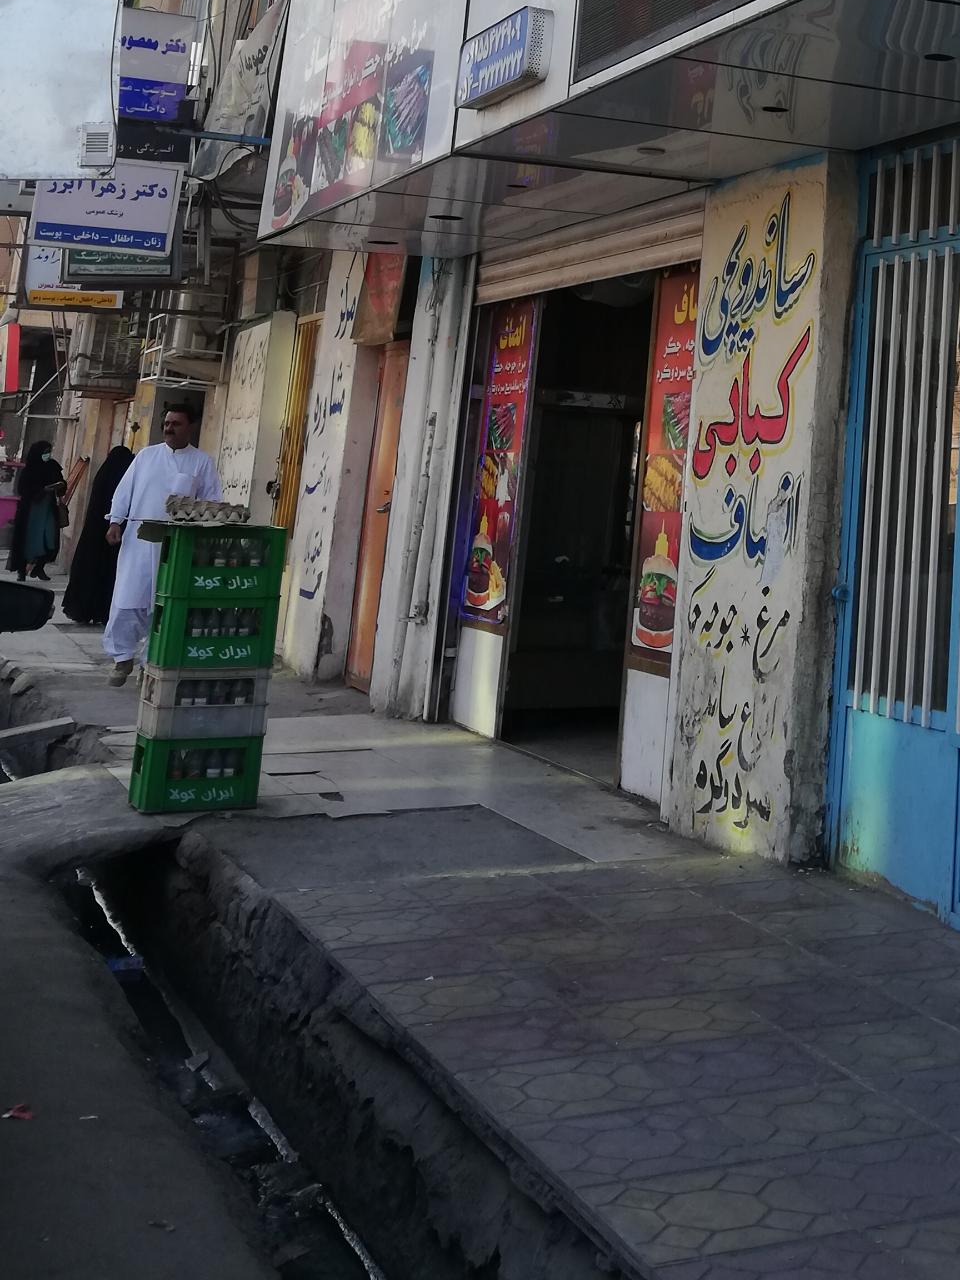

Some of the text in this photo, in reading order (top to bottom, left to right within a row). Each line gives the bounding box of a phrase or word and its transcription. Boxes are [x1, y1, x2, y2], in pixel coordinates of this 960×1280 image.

[130, 183, 168, 201] دکتر
[73, 232, 100, 242] داخلی
[110, 235, 133, 245] اطفال
[143, 236, 162, 248] زنان
[701, 191, 816, 359] ساندویچی
[691, 325, 811, 480] کبابی
[194, 575, 258, 589] ایران کولا
[187, 645, 252, 660] ایران کولا
[169, 786, 235, 802] ایران کولا
